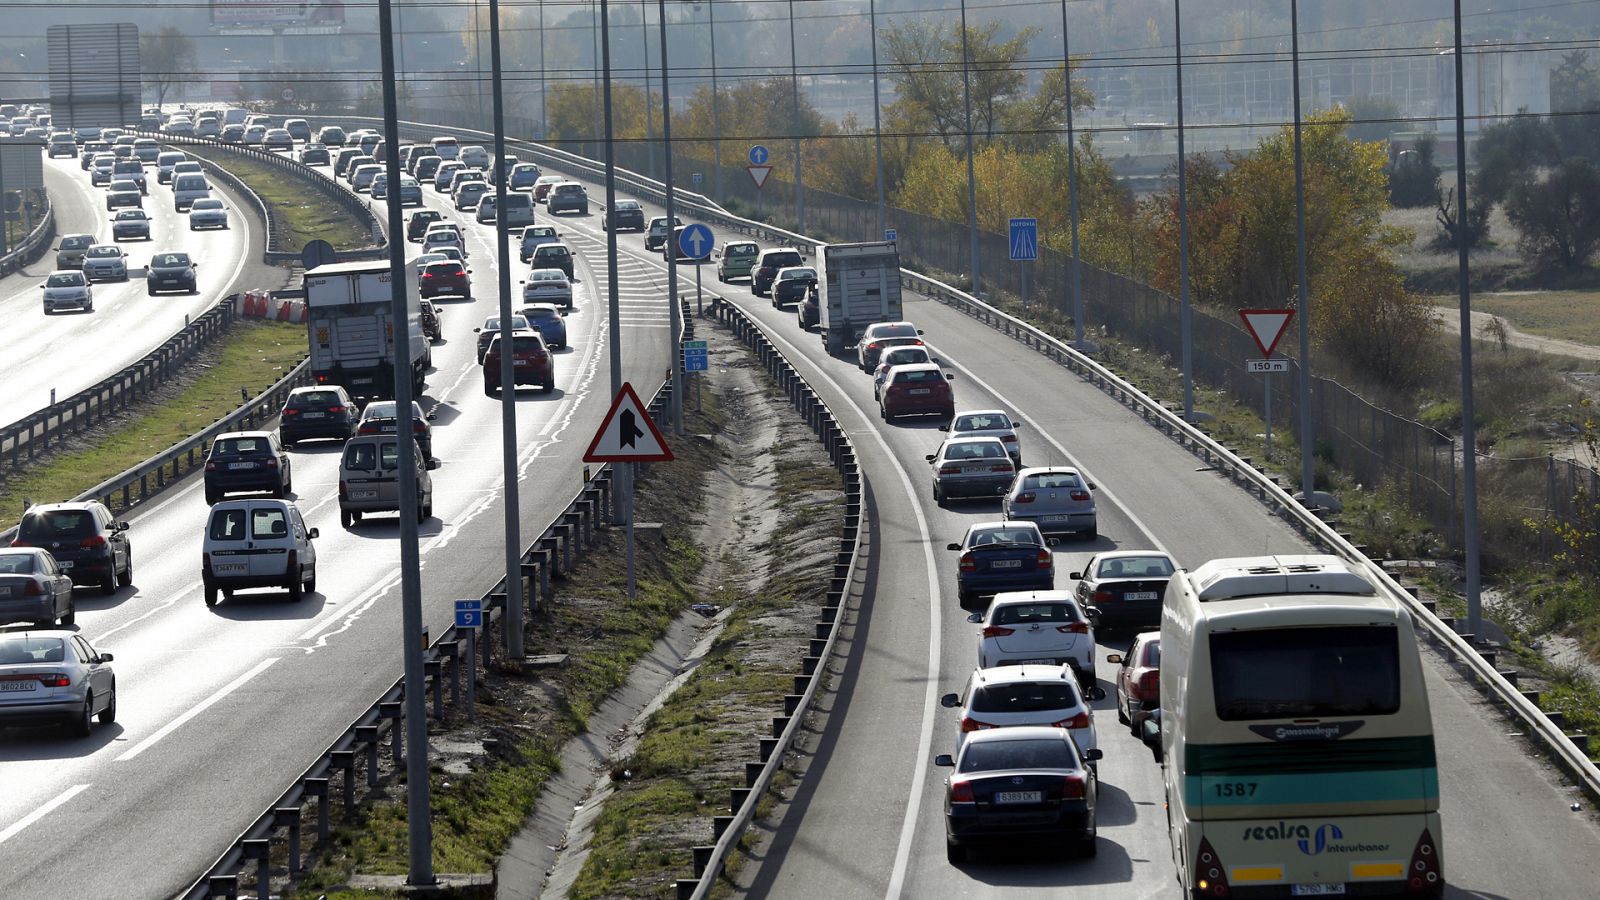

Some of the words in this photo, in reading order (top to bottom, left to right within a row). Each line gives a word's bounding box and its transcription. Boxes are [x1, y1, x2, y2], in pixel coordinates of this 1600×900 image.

[692, 362, 702, 370] 19
[464, 613, 473, 624] 9
[1215, 783, 1258, 797] 1587
[1002, 792, 1021, 801] 6389
[1243, 821, 1310, 841] sealsa
[1326, 843, 1390, 854] interurbanos
